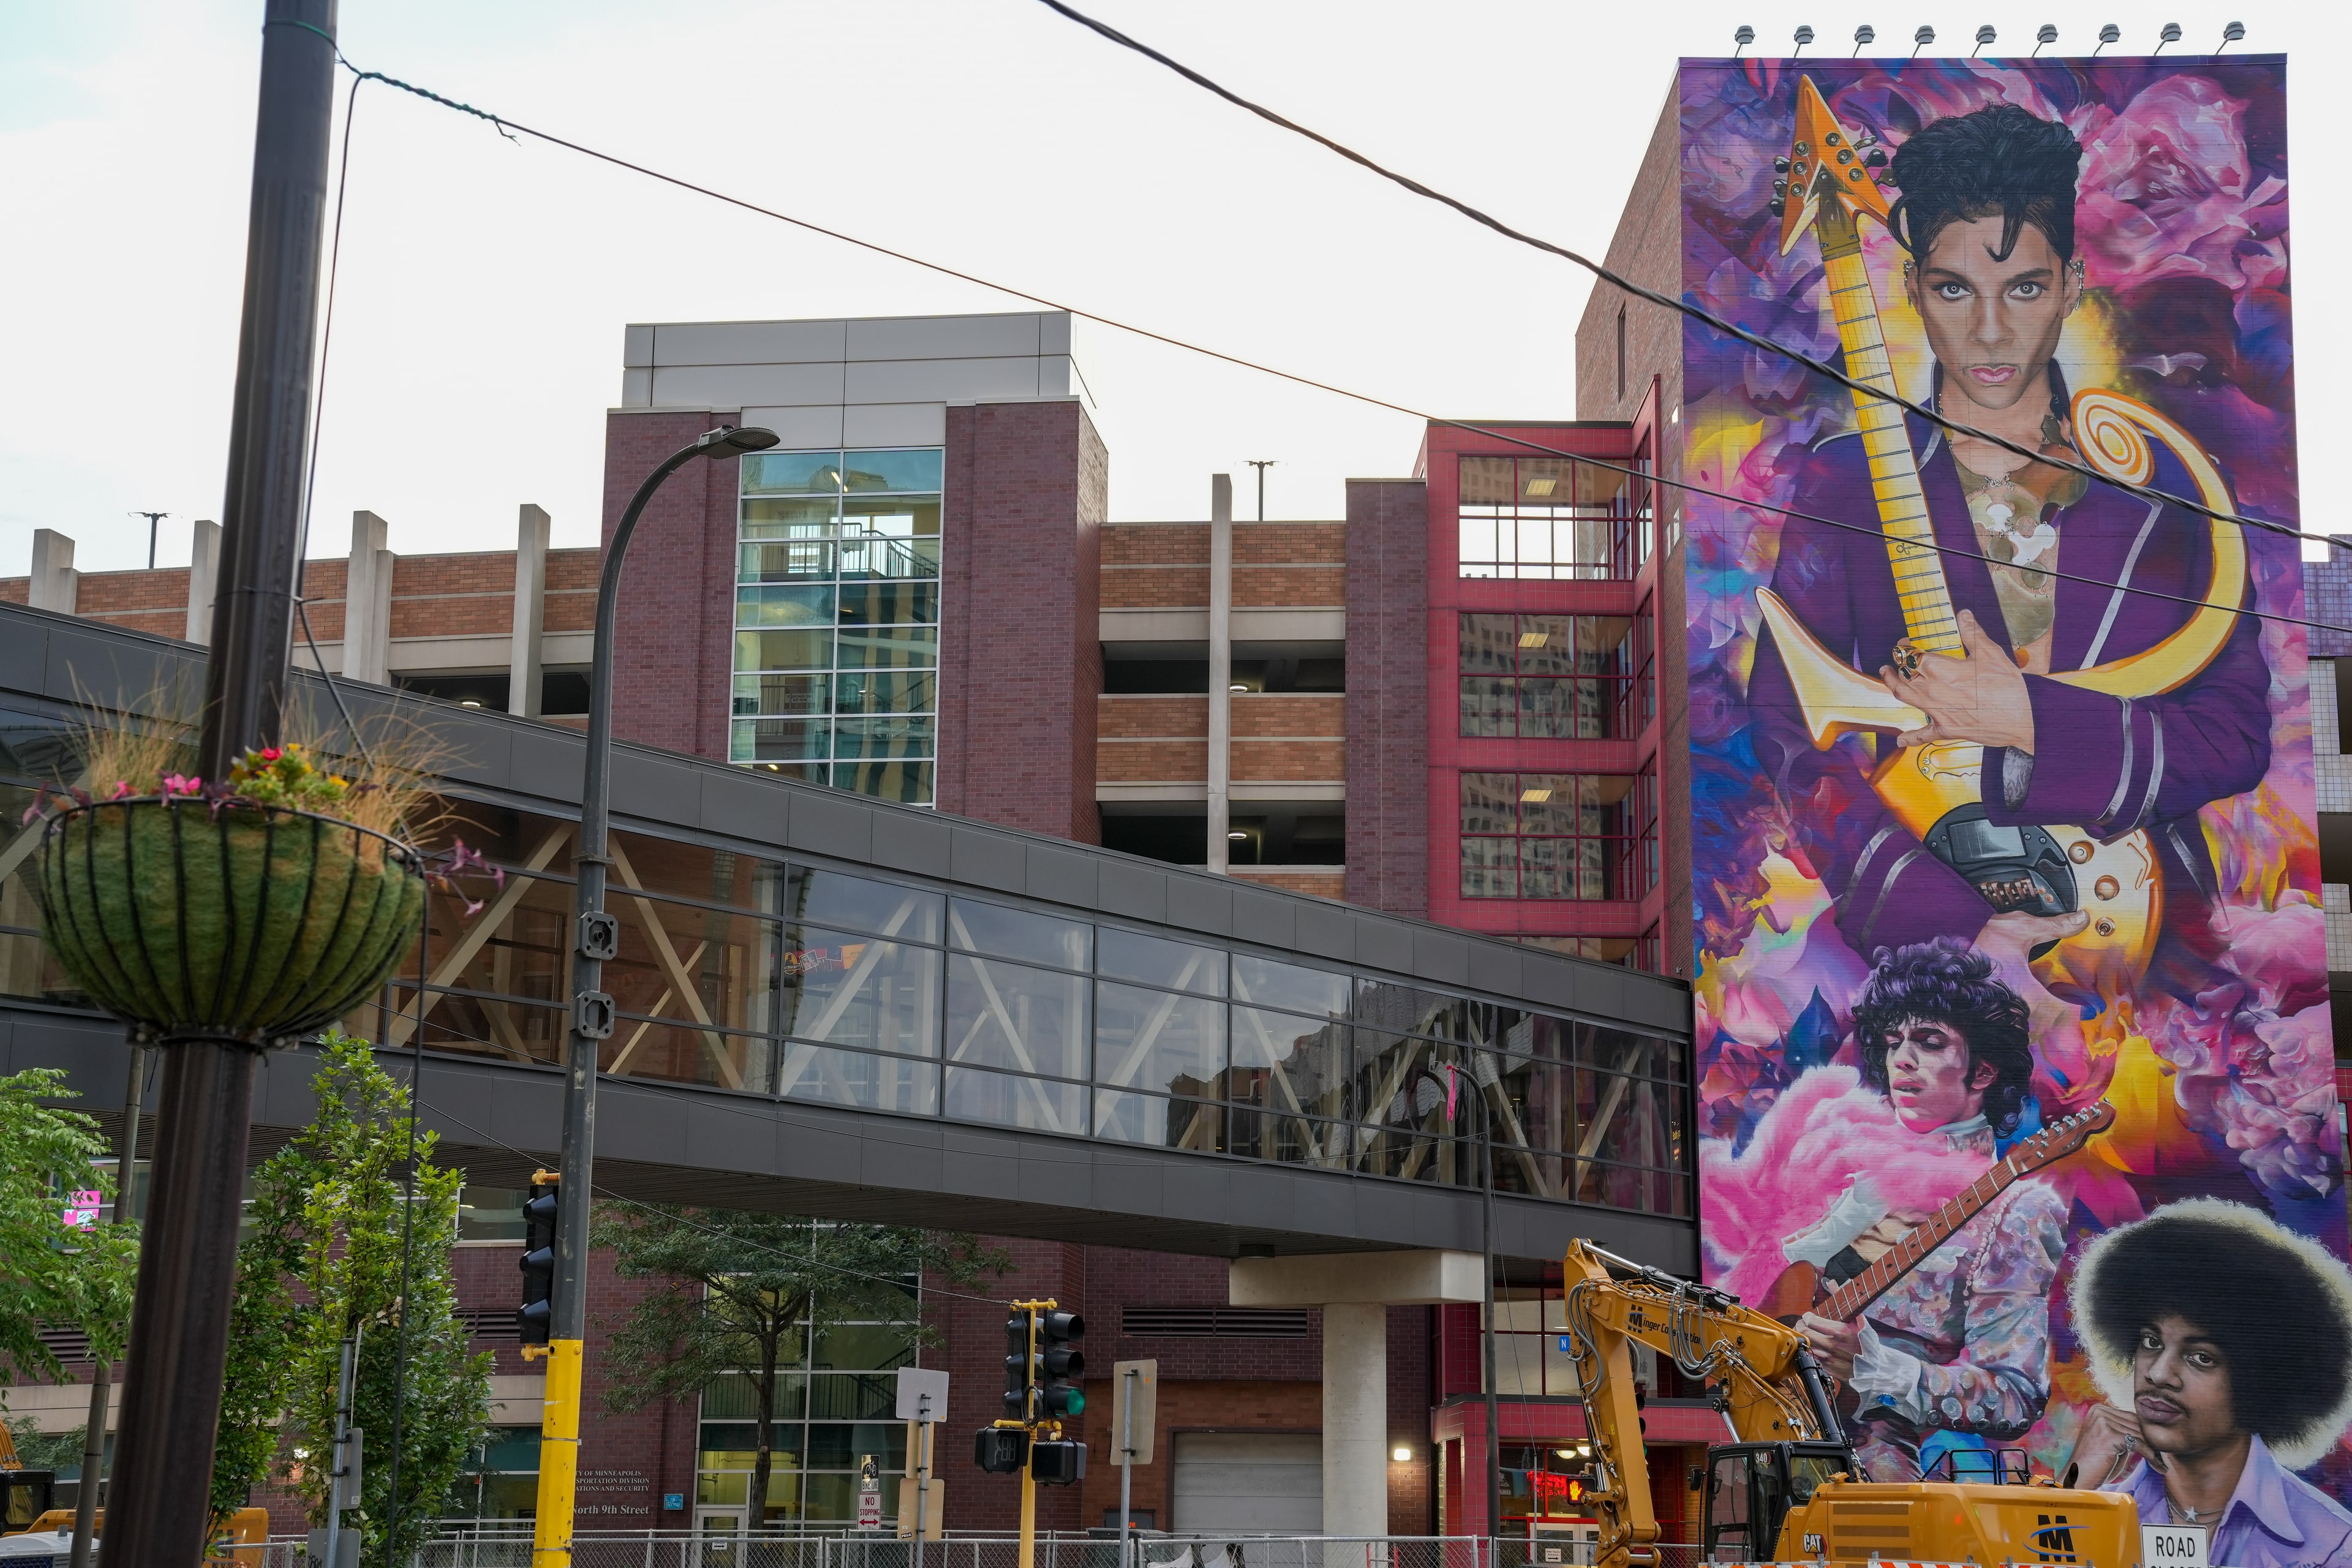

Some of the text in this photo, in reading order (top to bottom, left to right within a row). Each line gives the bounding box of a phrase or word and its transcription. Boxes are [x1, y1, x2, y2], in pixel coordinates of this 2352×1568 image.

[1627, 1304, 1660, 1334] Minger
[1561, 1339, 1567, 1348] N
[1755, 1453, 1768, 1463] 340
[865, 1497, 875, 1506] NO
[573, 1505, 649, 1514] North 9th Street
[1803, 1534, 1821, 1553] CAT
[2156, 1536, 2196, 1558] ROAD
